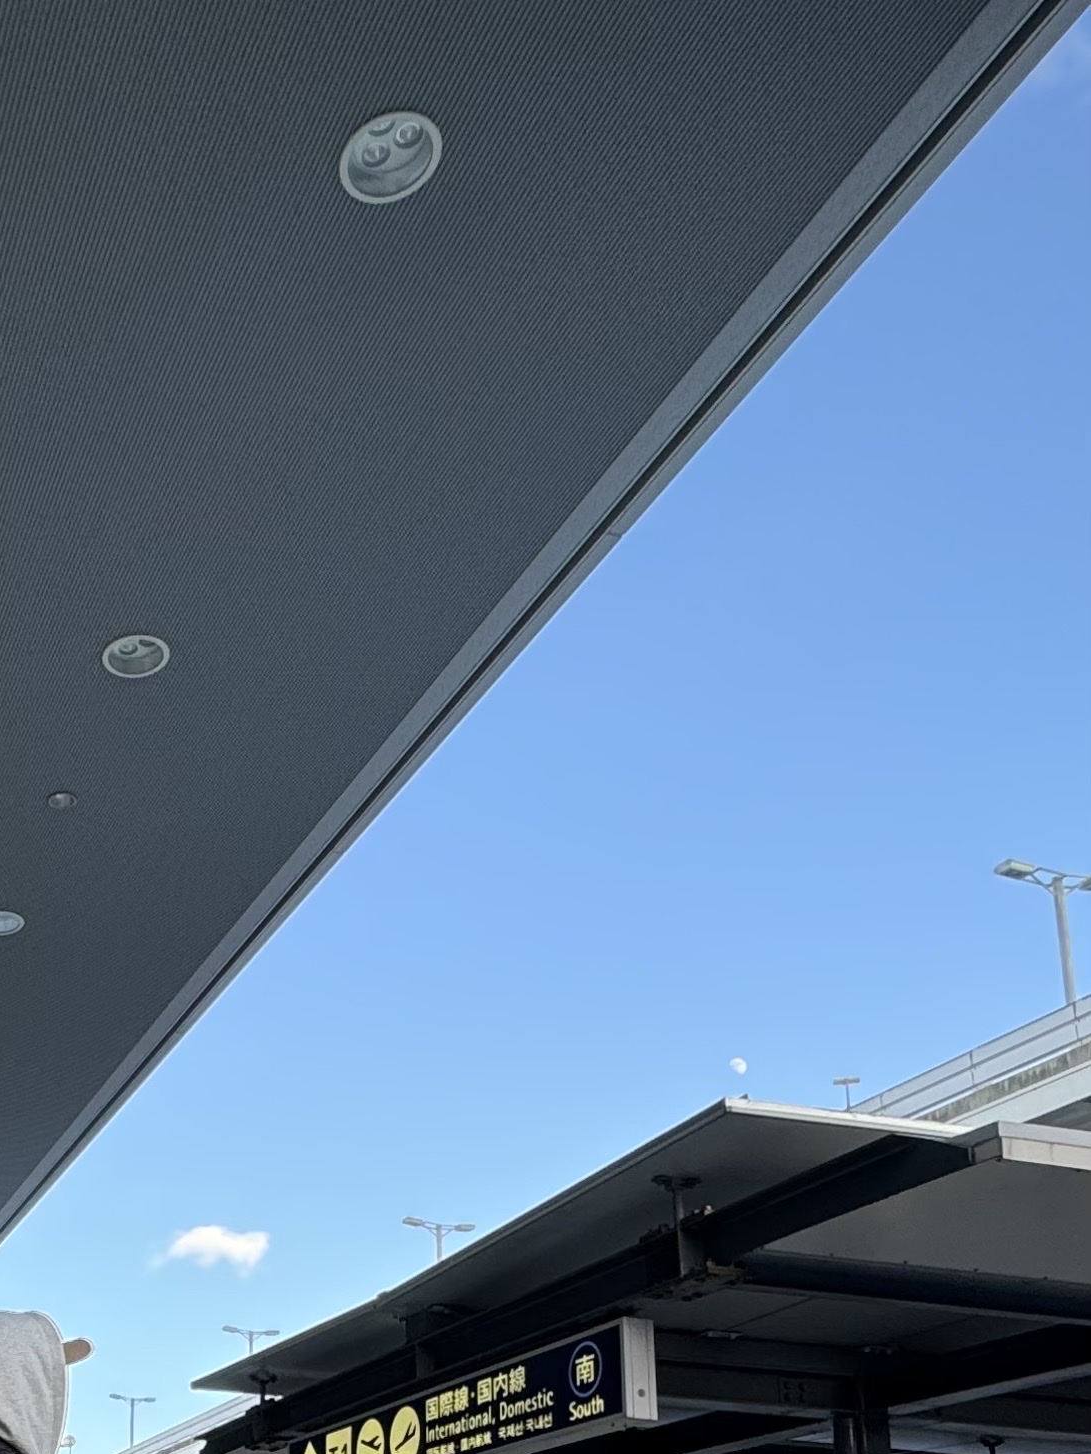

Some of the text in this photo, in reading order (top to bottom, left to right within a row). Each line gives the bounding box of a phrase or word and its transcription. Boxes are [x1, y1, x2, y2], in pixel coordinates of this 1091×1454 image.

[575, 1353, 596, 1387] 南
[426, 1388, 555, 1443] International, Domestic
[568, 1394, 605, 1422] South
